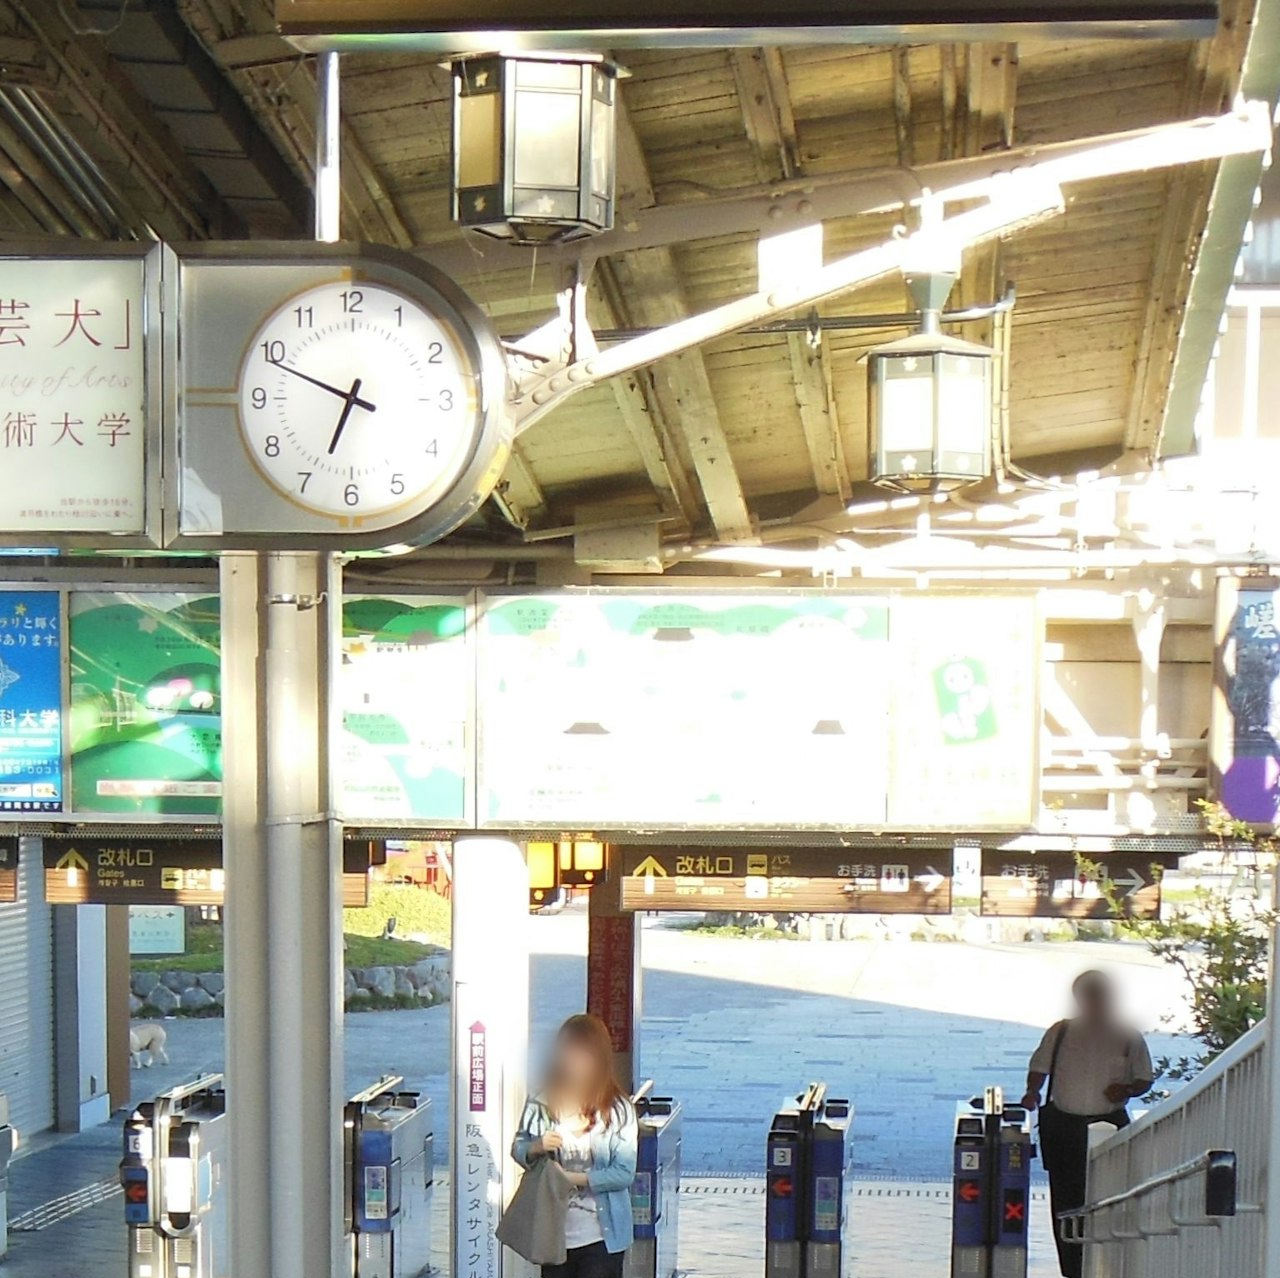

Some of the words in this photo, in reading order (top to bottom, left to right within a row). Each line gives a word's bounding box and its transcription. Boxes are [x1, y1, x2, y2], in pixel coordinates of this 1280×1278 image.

[340, 291, 363, 313] 12
[293, 307, 314, 329] 11
[394, 306, 402, 327] 1
[261, 340, 285, 362] 10
[428, 342, 442, 364] 2
[252, 388, 267, 410] 9
[439, 390, 454, 412] 3
[265, 436, 280, 458] 8
[425, 439, 438, 459] 4
[297, 472, 312, 494] 7
[390, 474, 405, 496] 5
[344, 485, 359, 507] 6
[97, 849, 154, 867] 改札口
[675, 856, 733, 875] 改札口
[97, 868, 125, 879] Gates
[837, 864, 876, 877] お手洗
[777, 1151, 786, 1163] 3
[966, 1155, 974, 1167] 2
